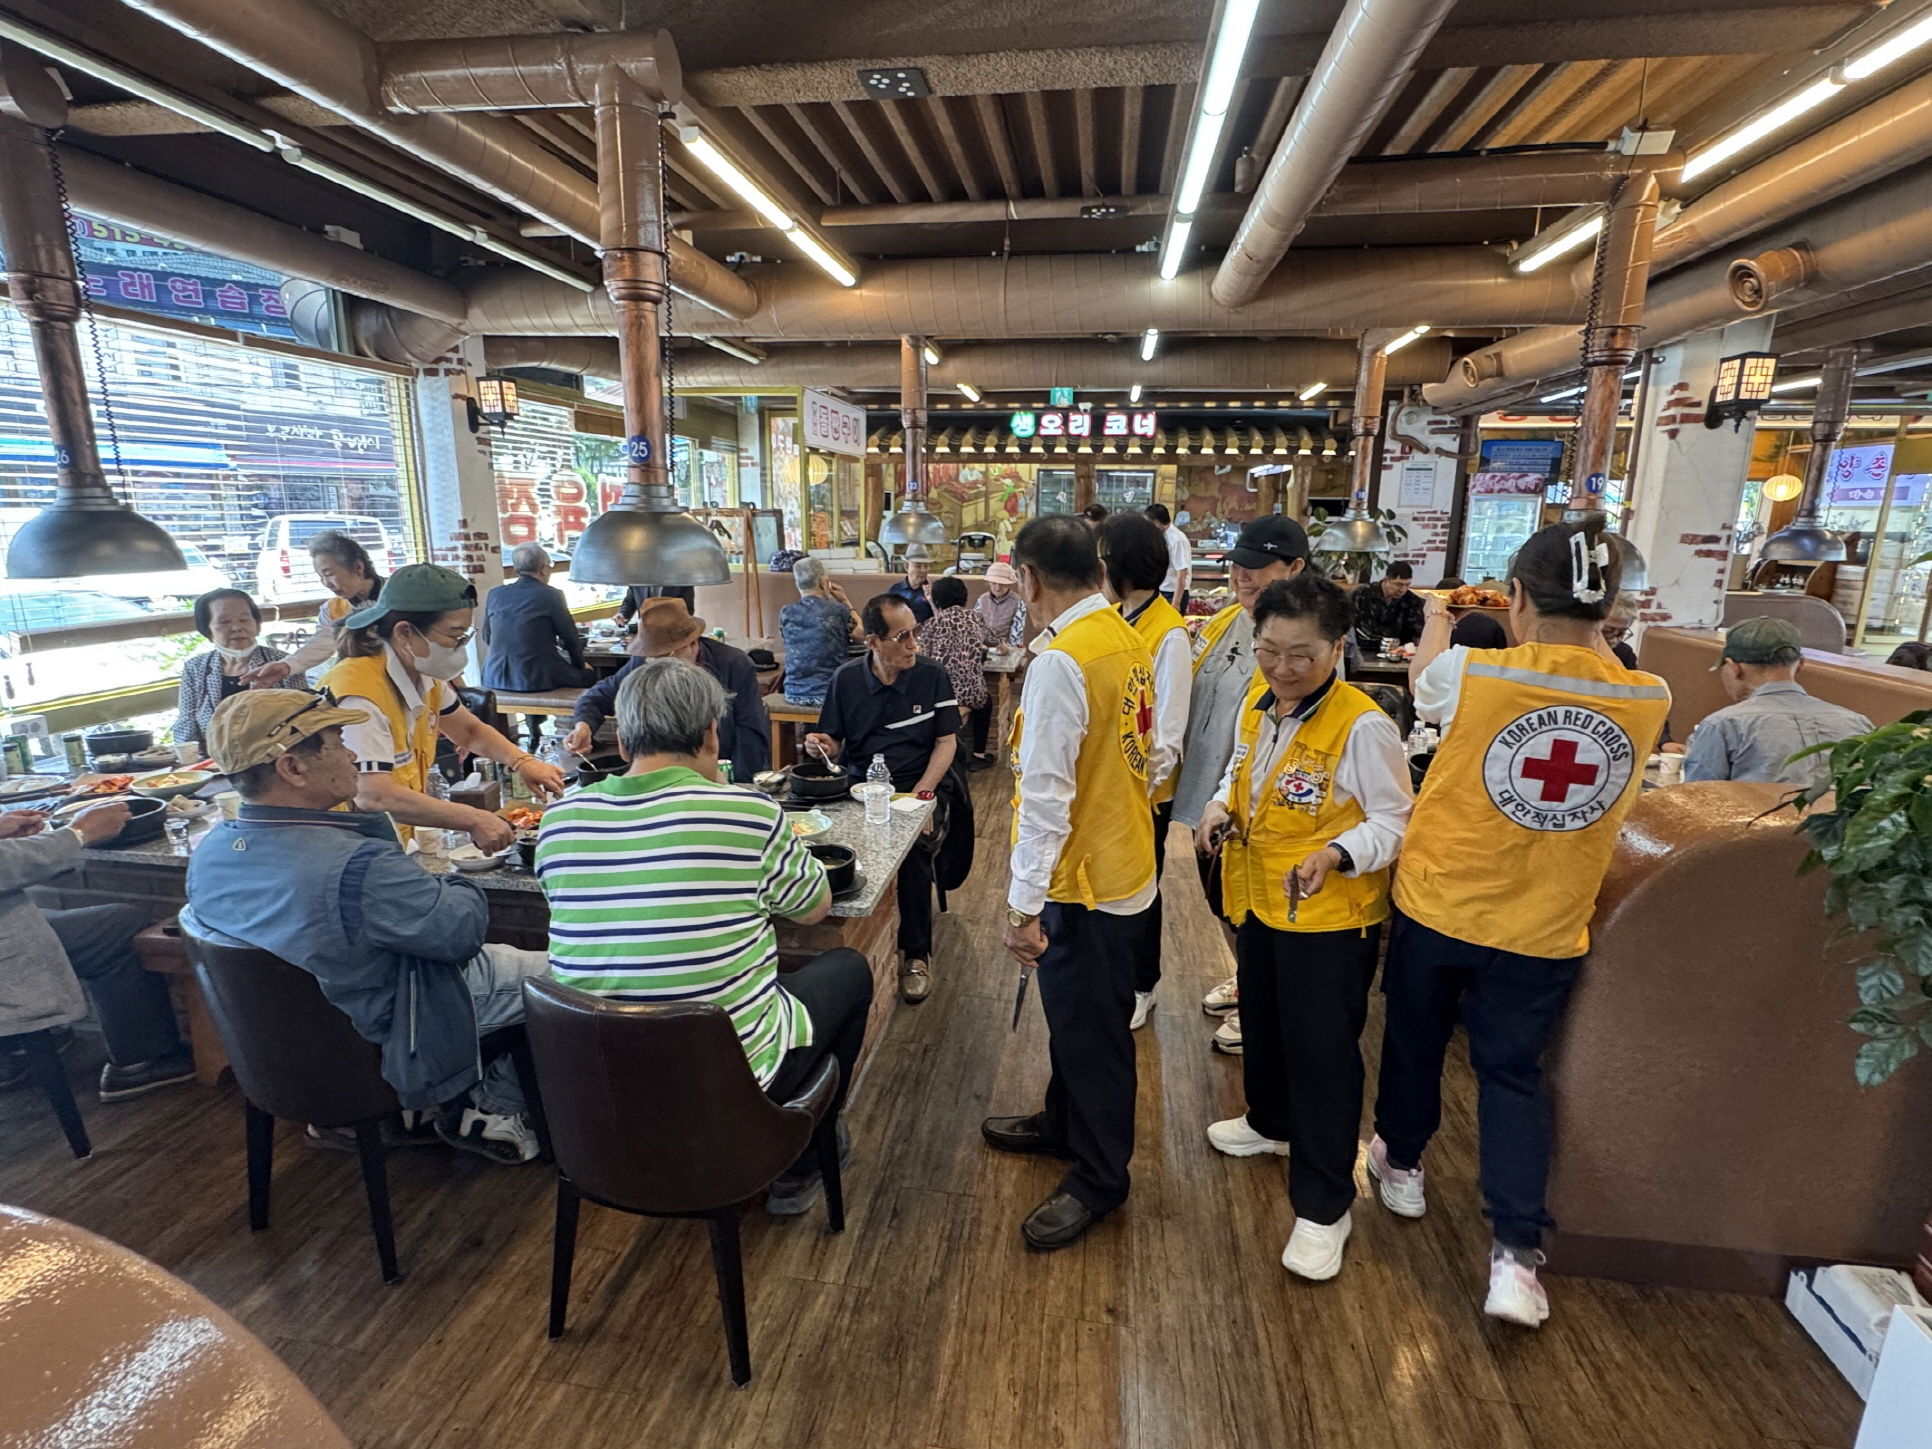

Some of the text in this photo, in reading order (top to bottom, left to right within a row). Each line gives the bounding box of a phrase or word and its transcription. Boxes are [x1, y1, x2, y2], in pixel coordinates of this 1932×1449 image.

[1010, 410, 1156, 439] 생오리 코너
[630, 441, 649, 458] 25
[1590, 476, 1604, 491] 19
[1498, 709, 1630, 762] KOREAN RED CROSS
[1121, 731, 1148, 775] KOREAN
[1498, 789, 1607, 829] 대한적십자사
